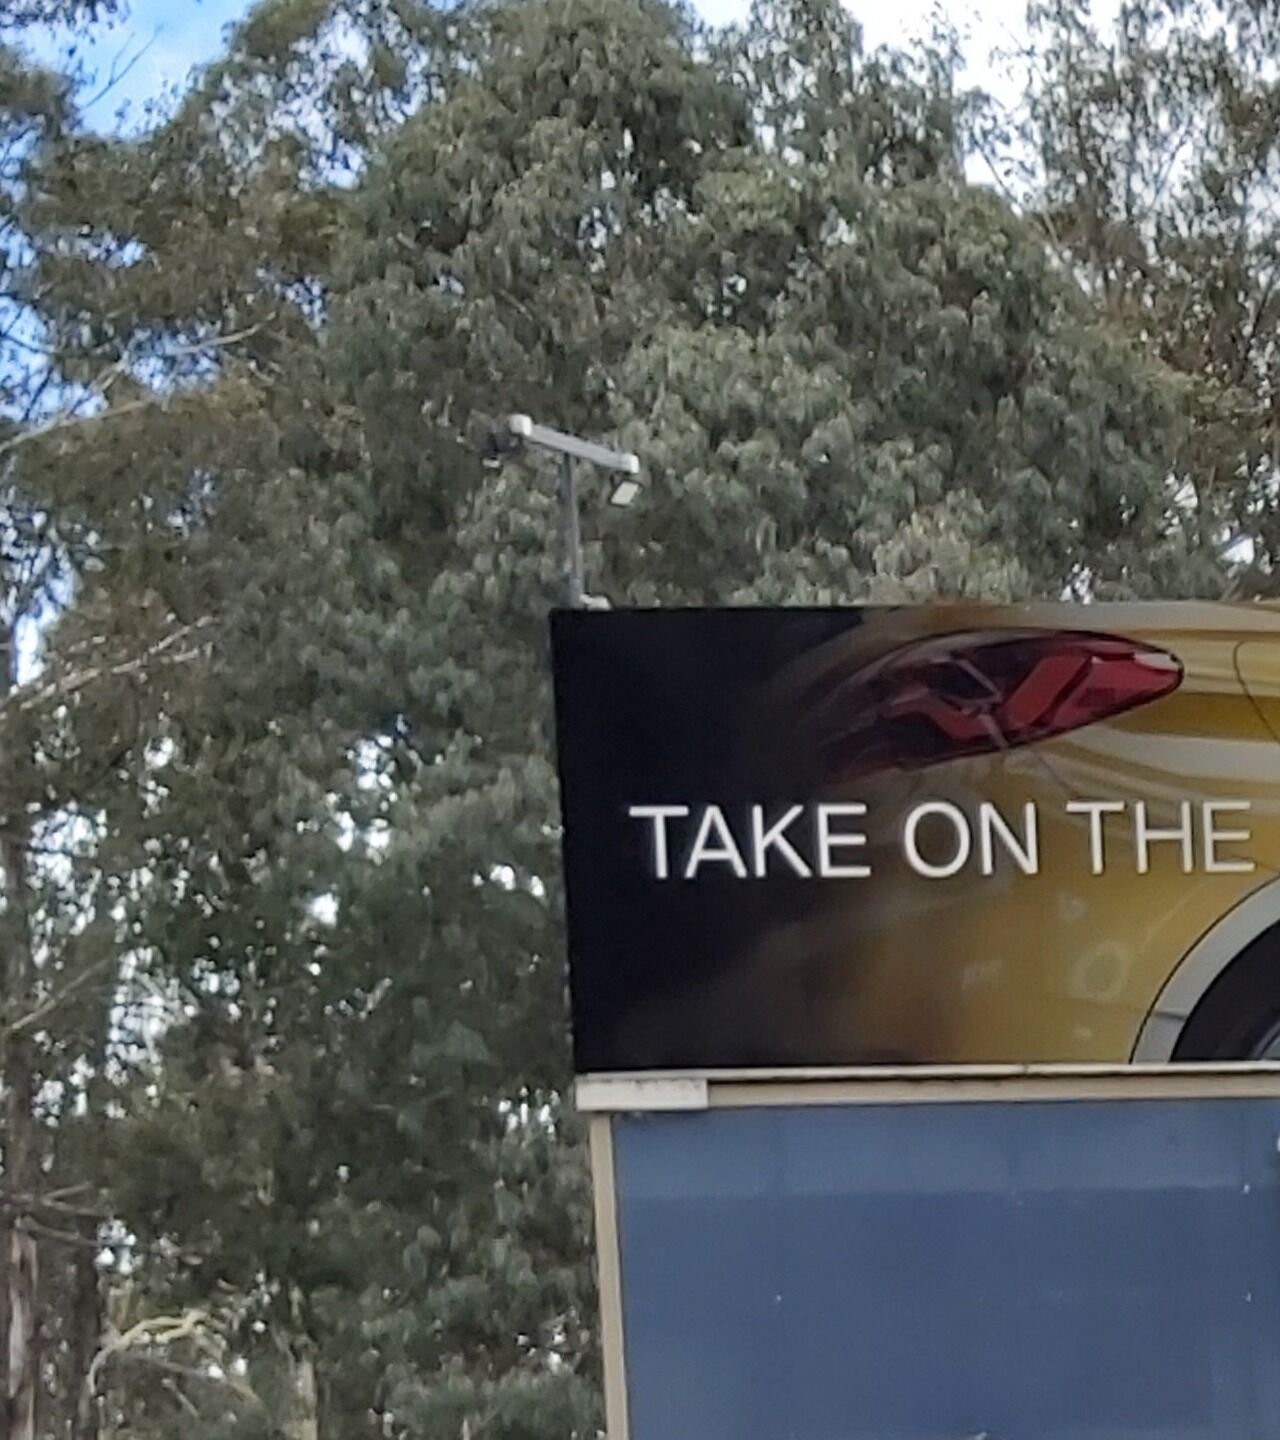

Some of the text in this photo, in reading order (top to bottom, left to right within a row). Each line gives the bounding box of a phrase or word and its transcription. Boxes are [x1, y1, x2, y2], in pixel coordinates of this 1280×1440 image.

[629, 802, 871, 880] TAKE
[903, 800, 1038, 877] ON
[1066, 798, 1257, 876] THE
